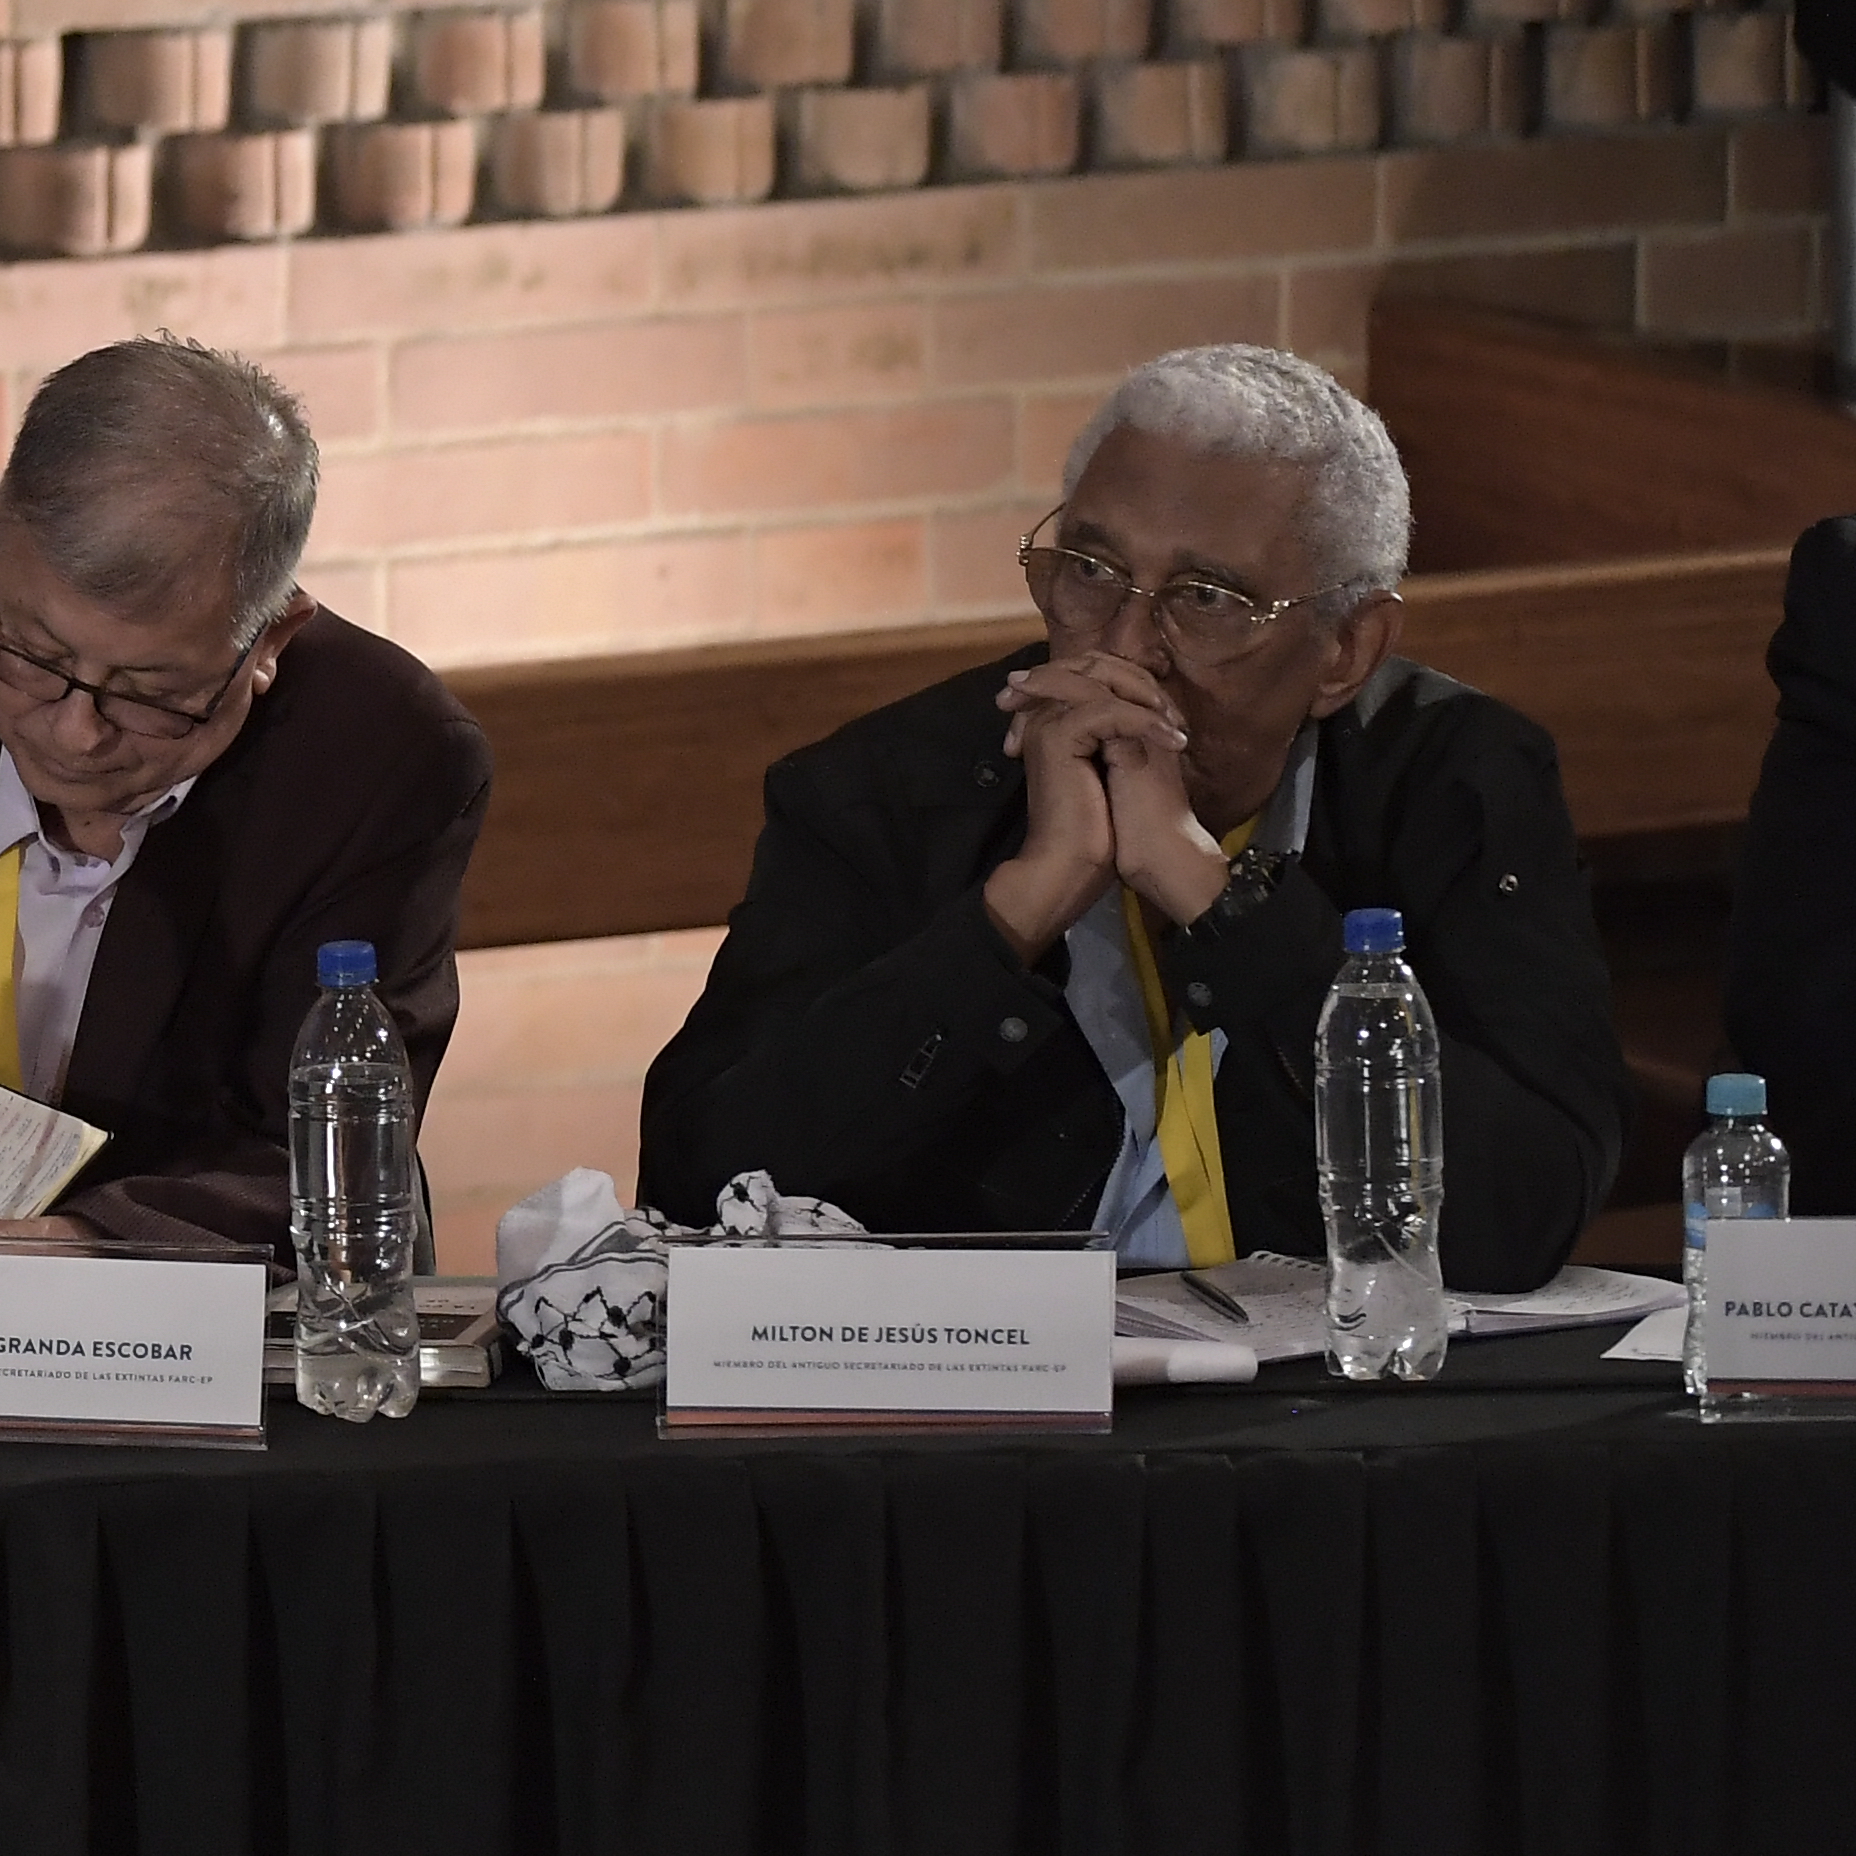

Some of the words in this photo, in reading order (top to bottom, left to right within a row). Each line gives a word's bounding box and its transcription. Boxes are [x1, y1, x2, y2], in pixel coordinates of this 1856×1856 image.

[1724, 1300, 1793, 1318] PABLO
[1799, 1302, 1856, 1319] CATA
[751, 1325, 834, 1343] MILTON
[841, 1326, 870, 1343] DE
[873, 1322, 939, 1344] JESÚS
[943, 1327, 1031, 1346] TONCEL
[92, 1340, 193, 1361] ESCOBAR
